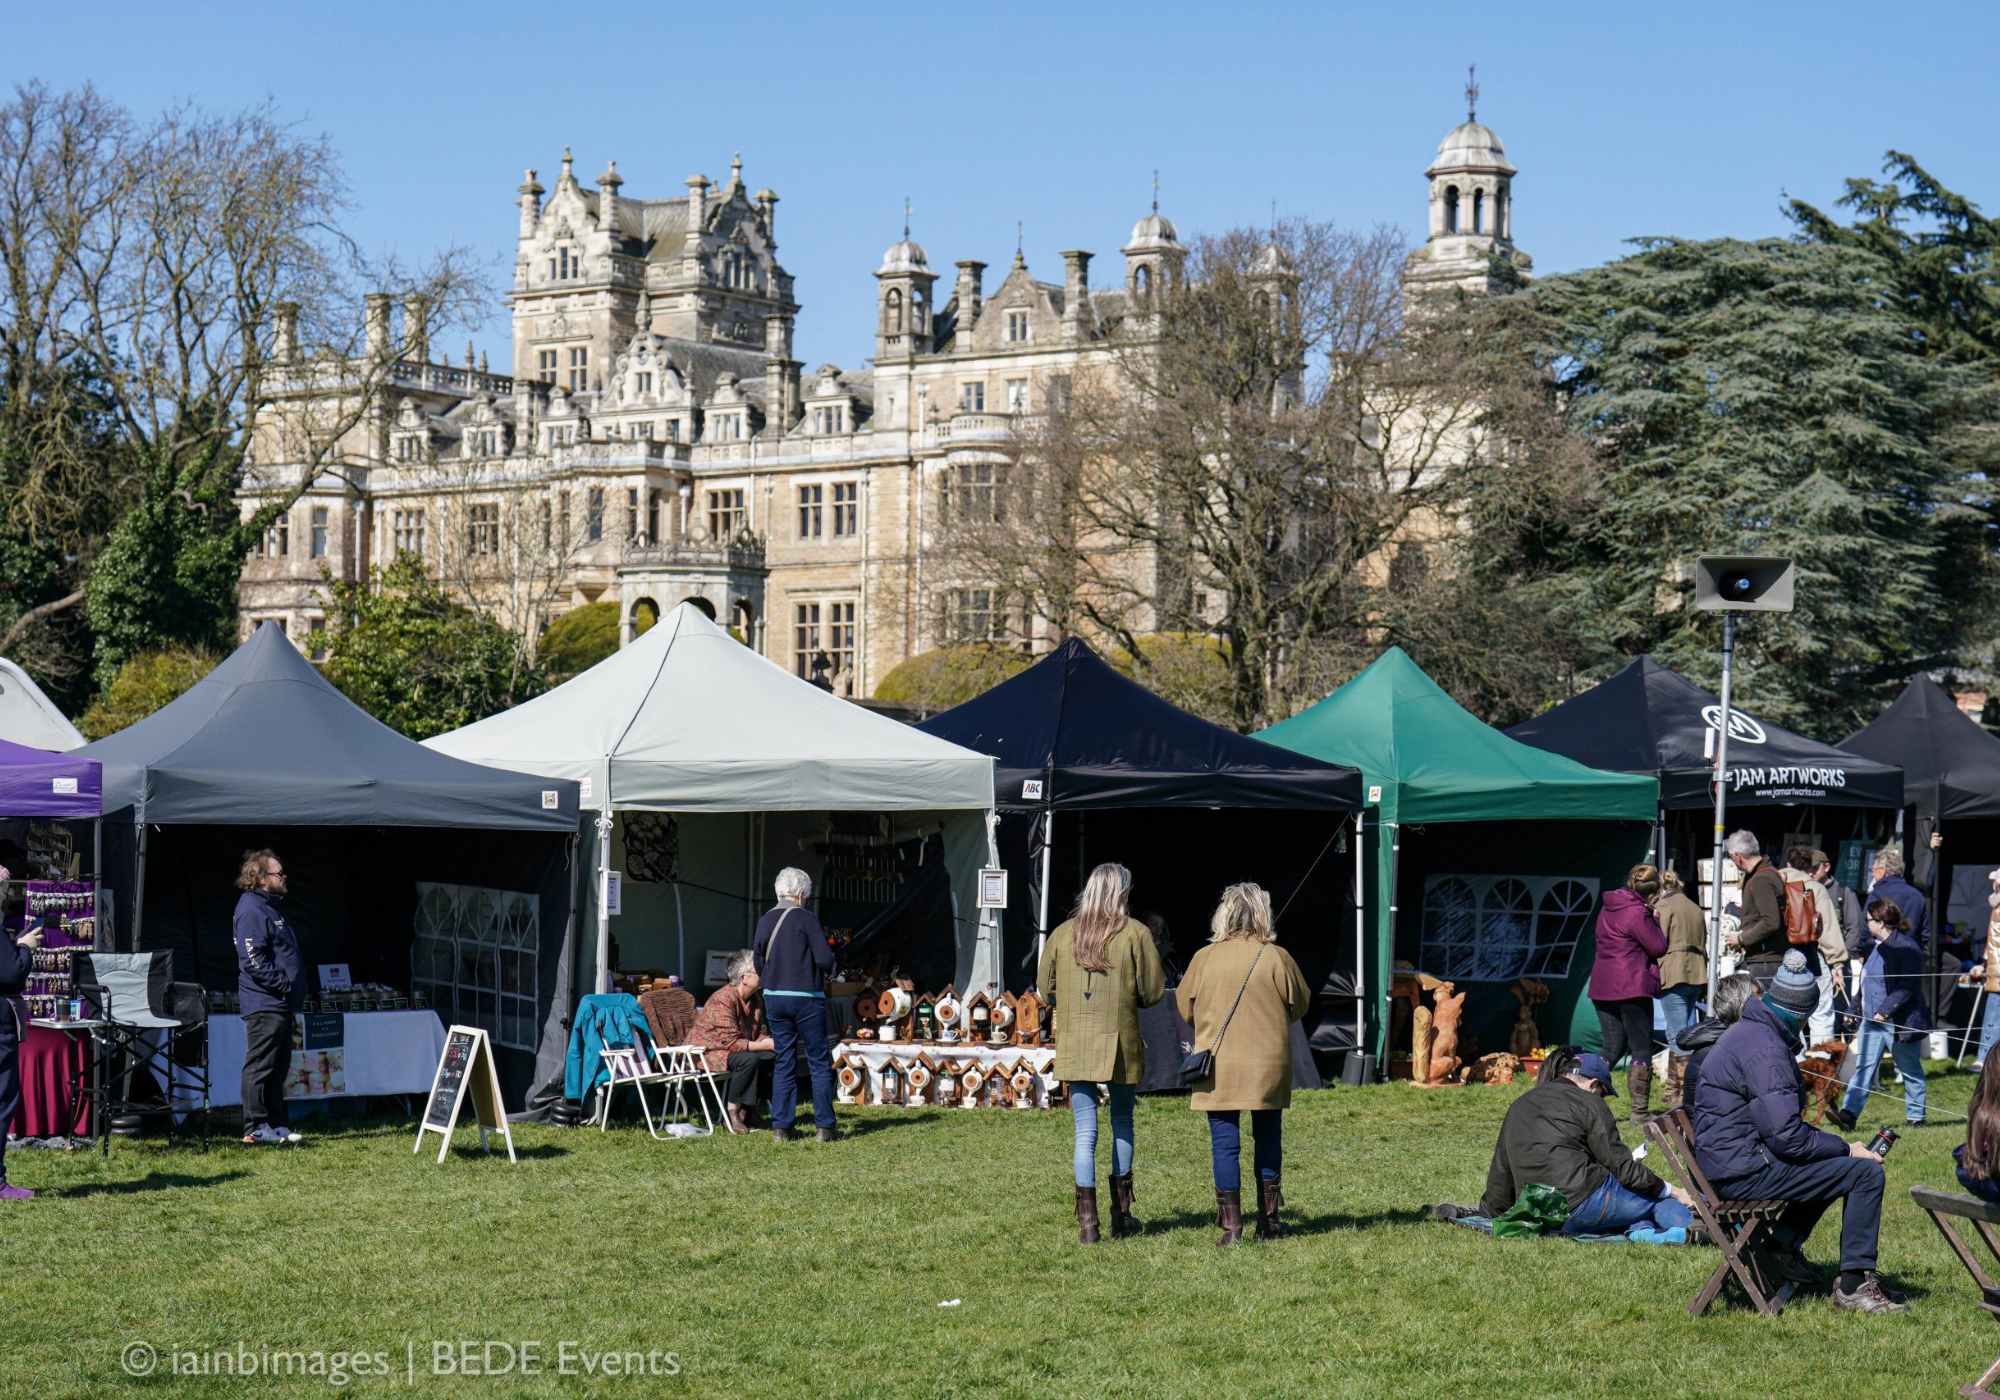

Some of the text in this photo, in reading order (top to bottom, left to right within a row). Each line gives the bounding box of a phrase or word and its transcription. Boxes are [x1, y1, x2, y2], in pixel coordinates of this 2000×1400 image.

[1733, 767, 1846, 791] JAM ARTWORKS
[1025, 783, 1041, 794] ABC
[1755, 787, 1826, 798] www.jamartworks.com
